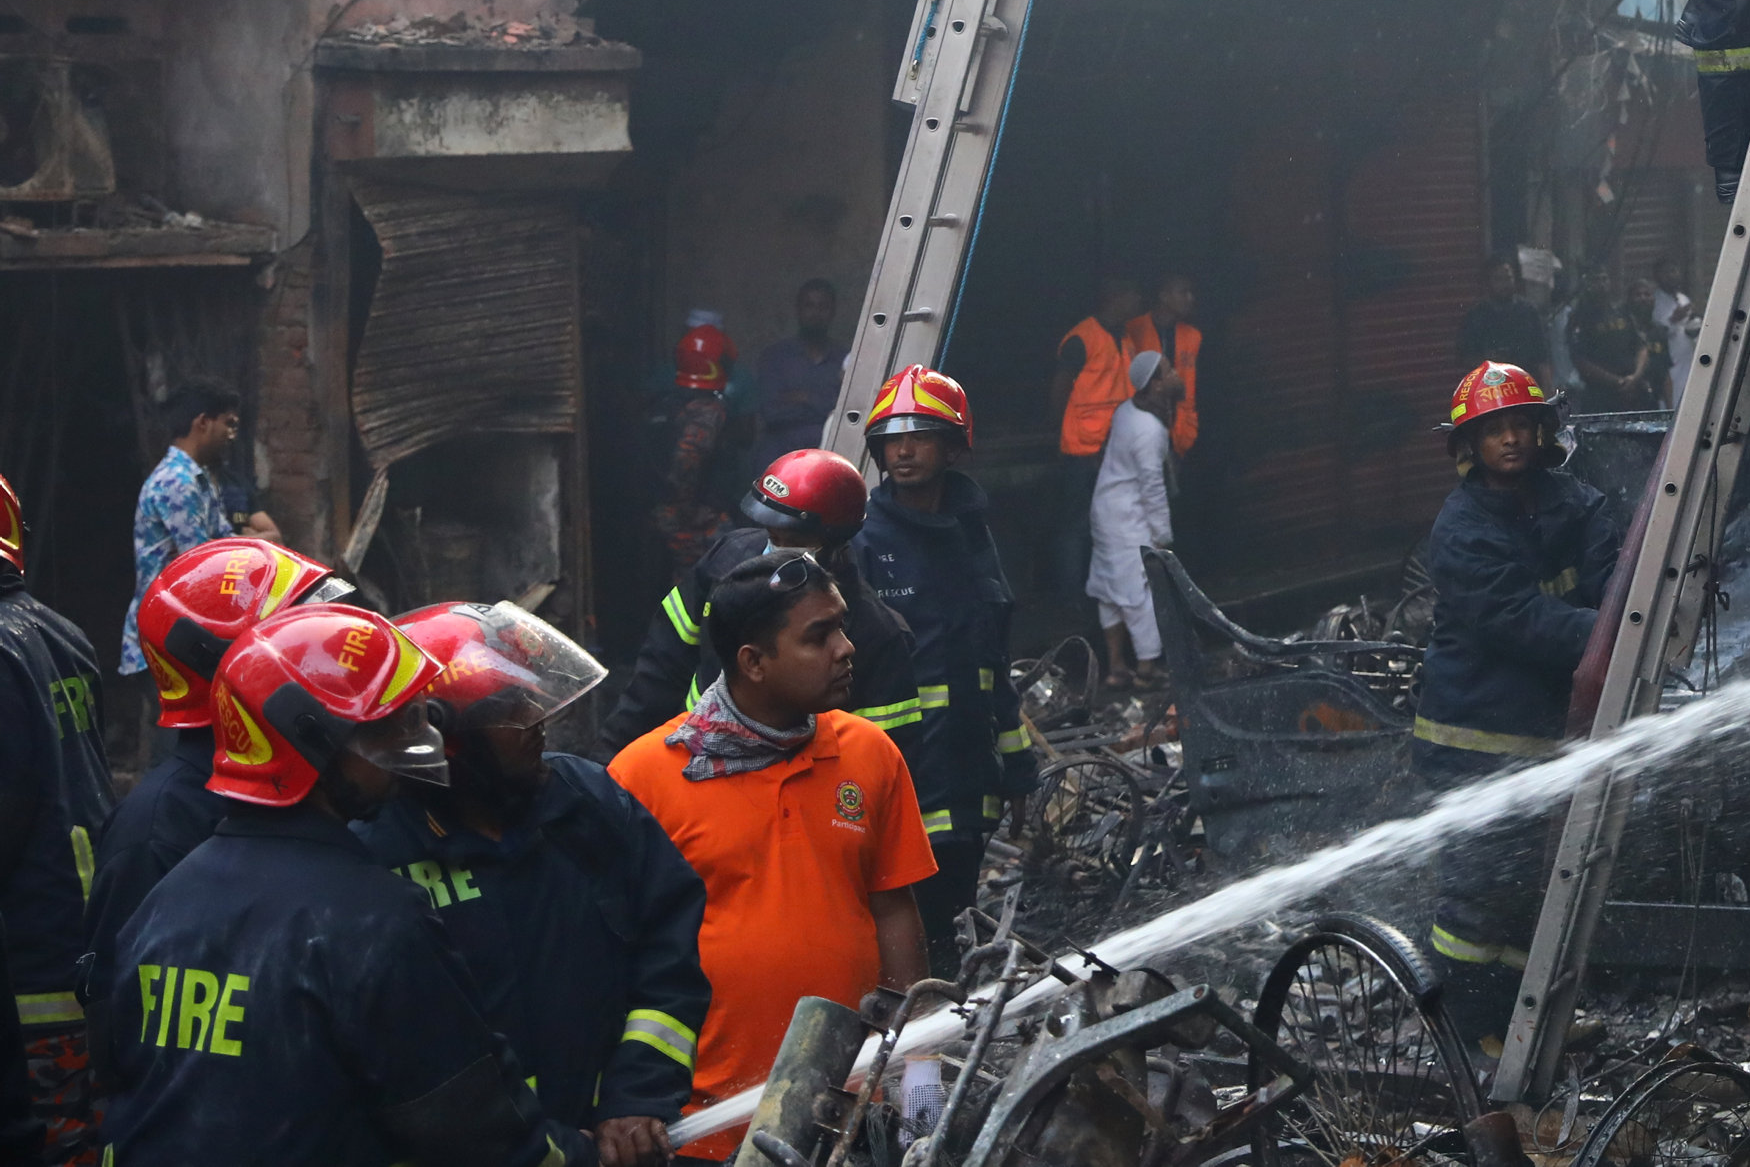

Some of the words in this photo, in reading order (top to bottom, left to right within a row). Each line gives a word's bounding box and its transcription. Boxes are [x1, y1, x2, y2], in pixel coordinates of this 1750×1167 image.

[219, 549, 250, 596] FIRE
[337, 620, 376, 672] FIRE
[138, 964, 250, 1057] FIRE
